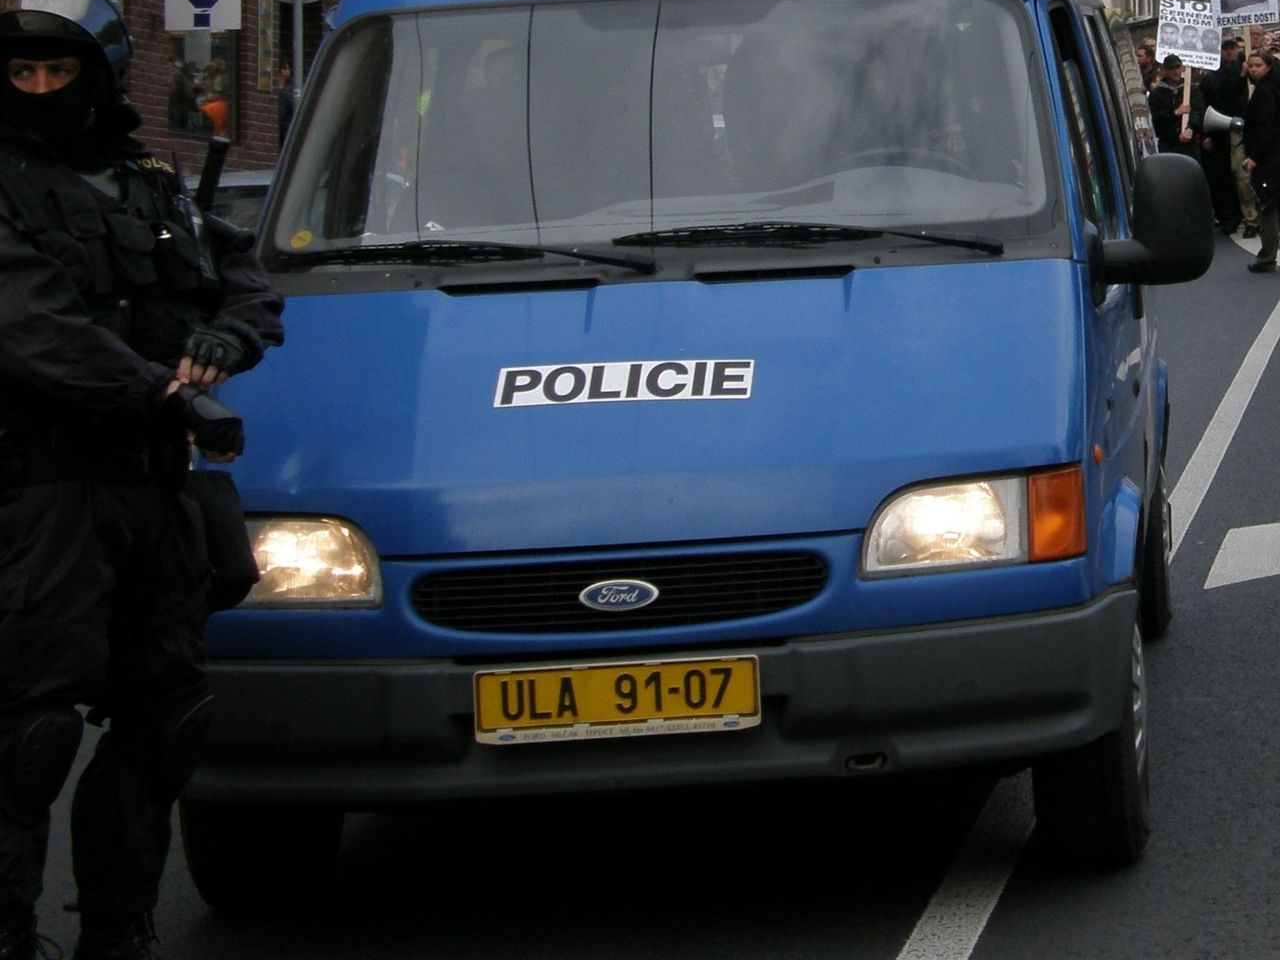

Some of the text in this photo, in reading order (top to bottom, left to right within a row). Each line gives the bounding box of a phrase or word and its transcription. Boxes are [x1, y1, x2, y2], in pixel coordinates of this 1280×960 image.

[1160, 8, 1213, 21] ČERNÉM
[1160, 15, 1213, 27] RASISM
[500, 361, 751, 406] POLICIE
[597, 585, 640, 603] Ford
[500, 667, 733, 721] ULA 91-07
